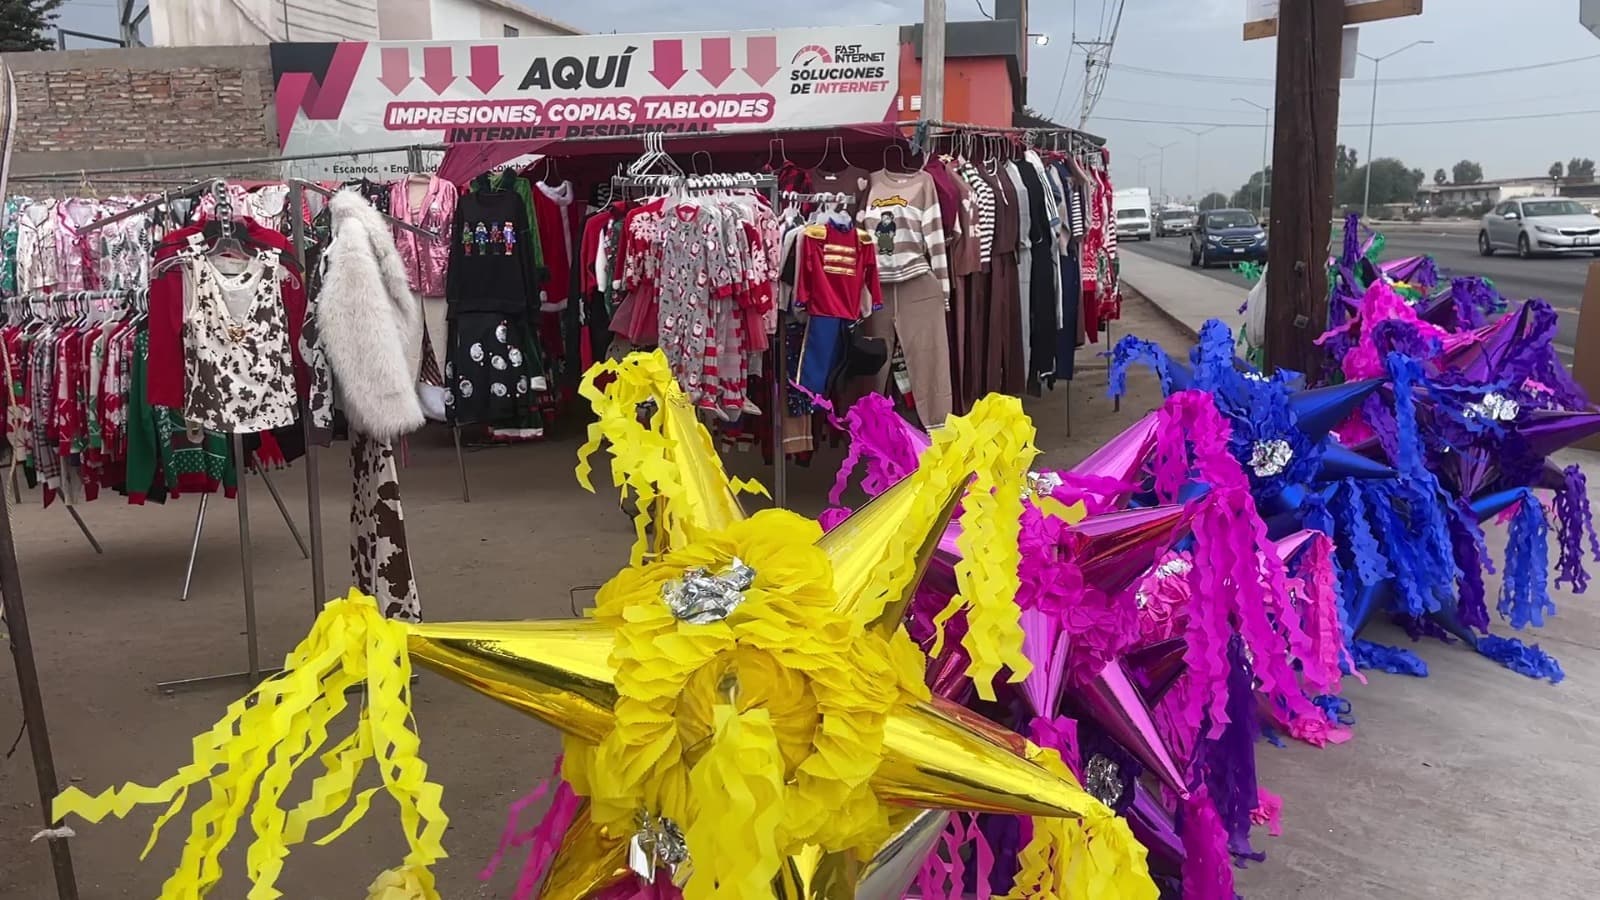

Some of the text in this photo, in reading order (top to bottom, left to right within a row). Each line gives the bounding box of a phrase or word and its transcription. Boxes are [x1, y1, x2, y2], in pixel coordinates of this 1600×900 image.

[835, 44, 862, 54] FAST
[835, 52, 885, 63] INTERNET
[517, 46, 638, 90] AQUÍ
[790, 67, 885, 81] SOLUCIONES
[790, 80, 889, 95] DE INTERNET
[389, 98, 769, 125] IMPRESIONES, COPIAS, TABLOIDES
[450, 125, 560, 142] INTERNET
[333, 164, 379, 174] Escaneos
